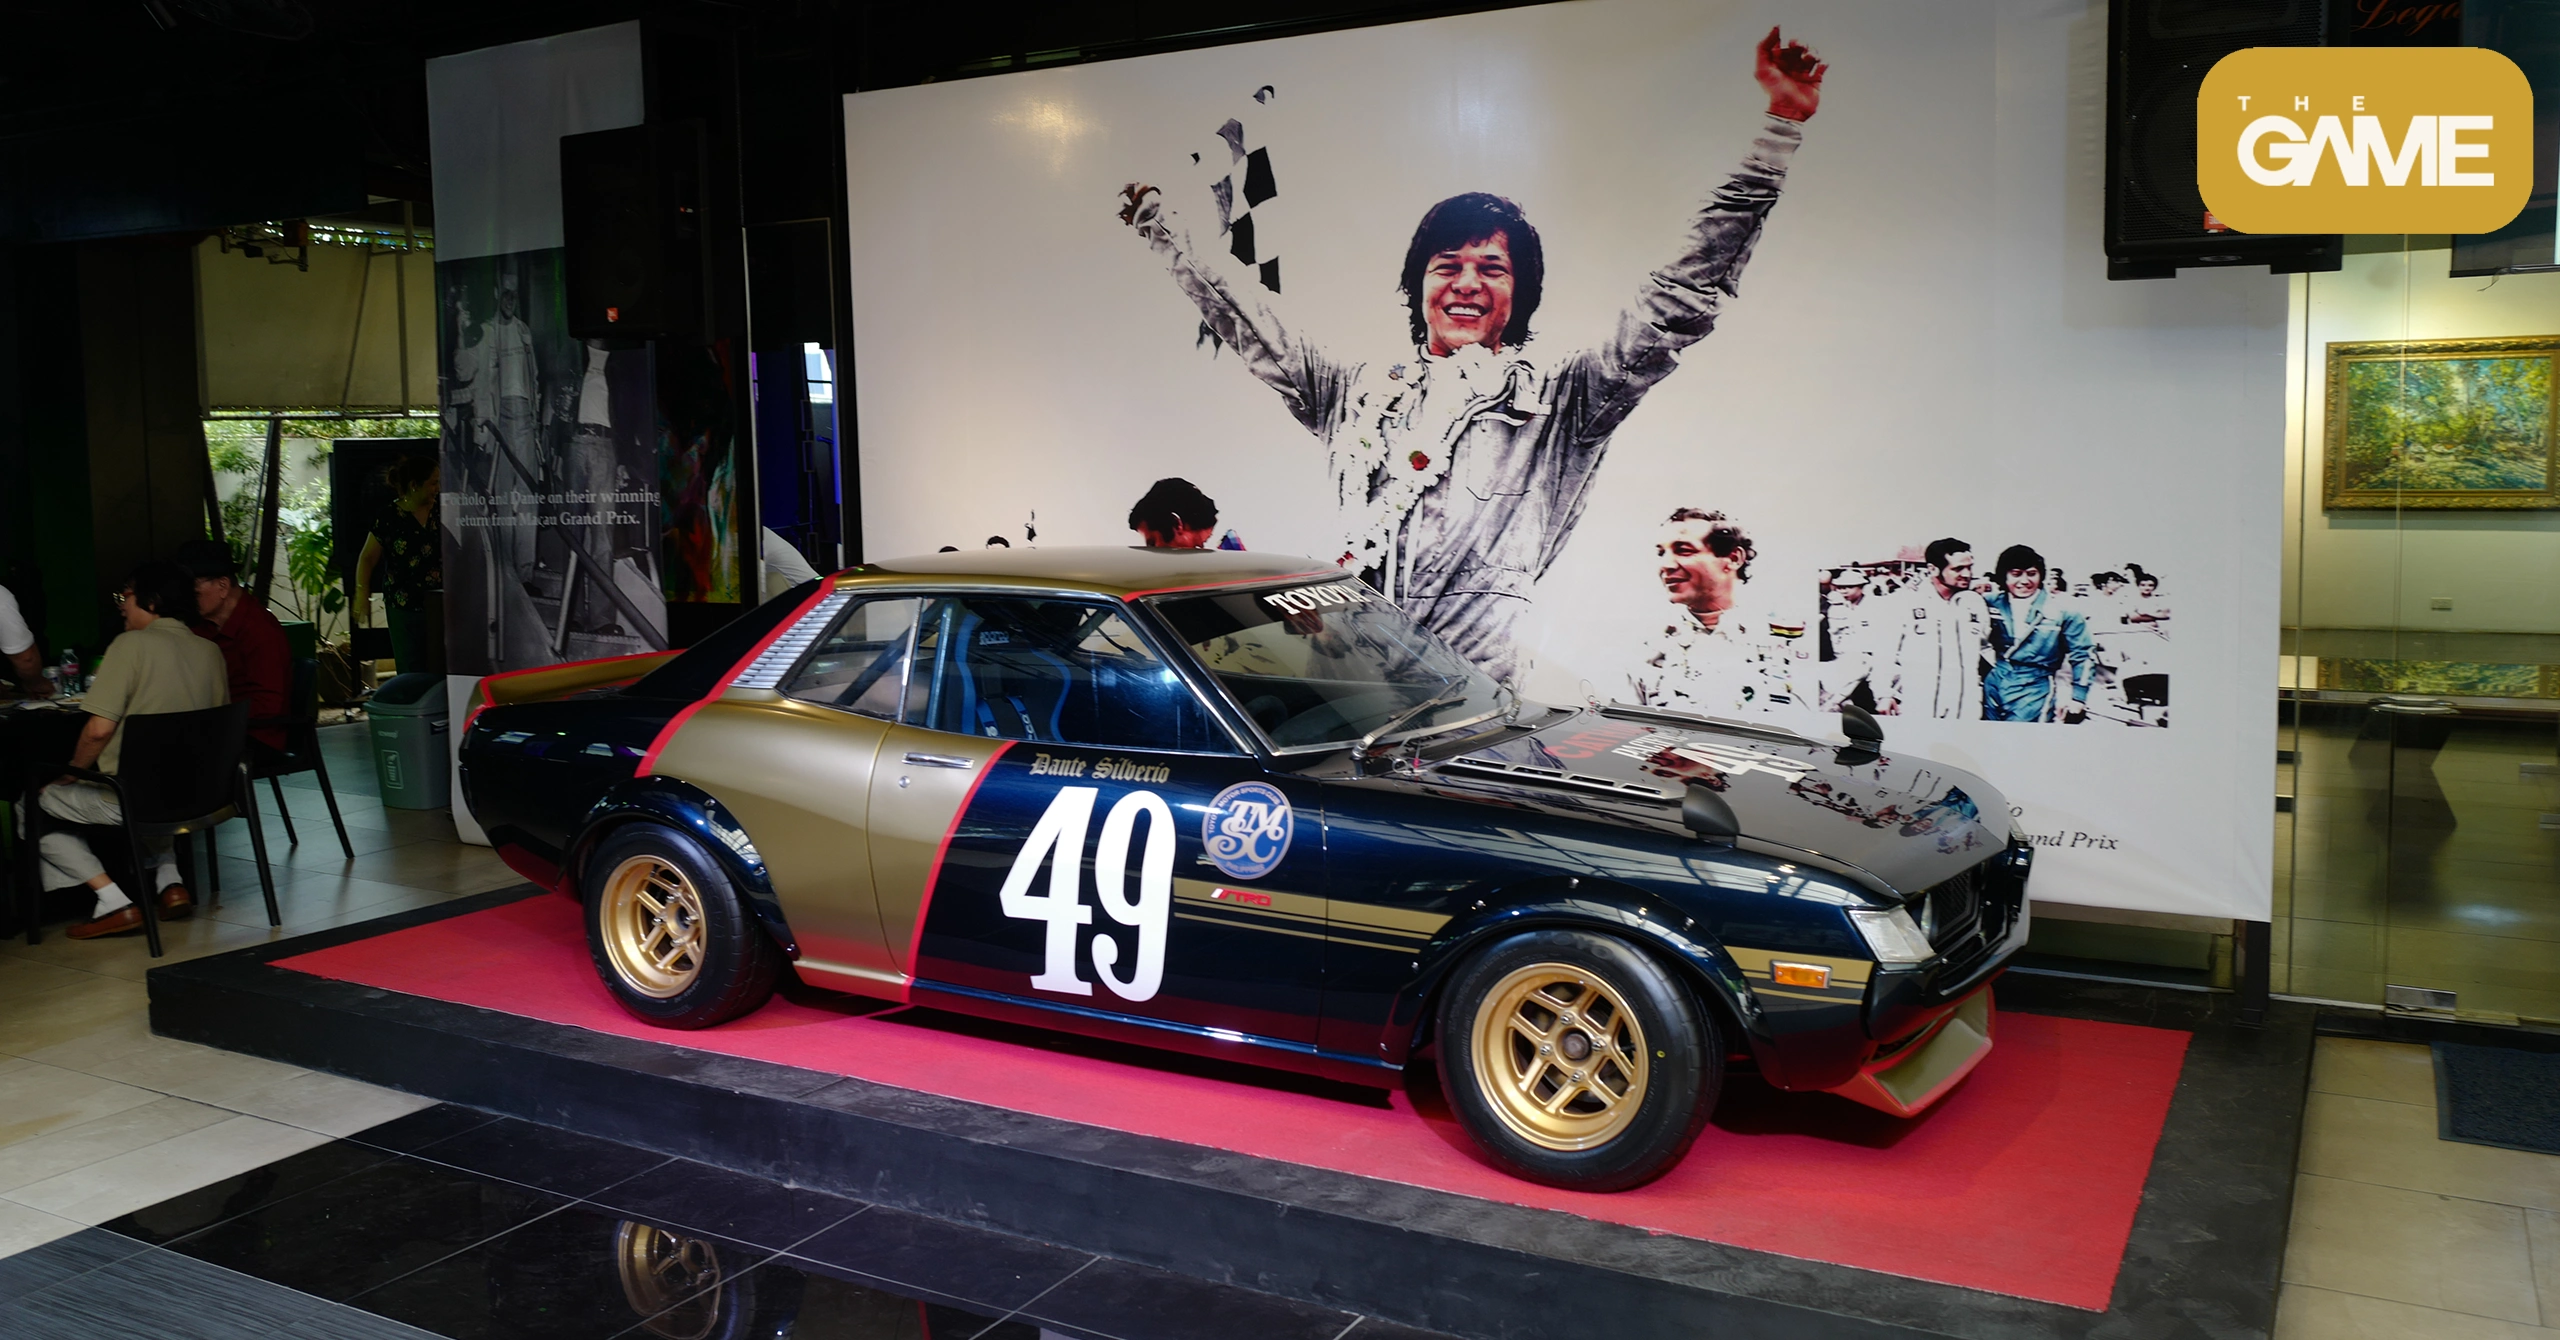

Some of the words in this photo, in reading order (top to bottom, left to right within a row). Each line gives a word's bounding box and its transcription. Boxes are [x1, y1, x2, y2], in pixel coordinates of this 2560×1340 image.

[488, 492, 509, 505] and
[510, 491, 546, 505] Dante
[547, 492, 563, 504] on
[565, 489, 597, 504] their
[599, 488, 661, 507] winning
[456, 515, 490, 527] return
[491, 513, 517, 526] from
[518, 513, 558, 527] Macau
[560, 511, 602, 526] Grand
[605, 510, 641, 525] Prix.
[1263, 584, 1373, 615] TOYOTA
[1028, 752, 1087, 778] Dante
[1091, 756, 1171, 784] Silverio
[1670, 742, 1817, 784] 49
[1218, 789, 1241, 807] MOTOR
[2070, 831, 2119, 851] Prix
[999, 785, 1176, 1002] 49
[1218, 888, 1272, 907] TRD
